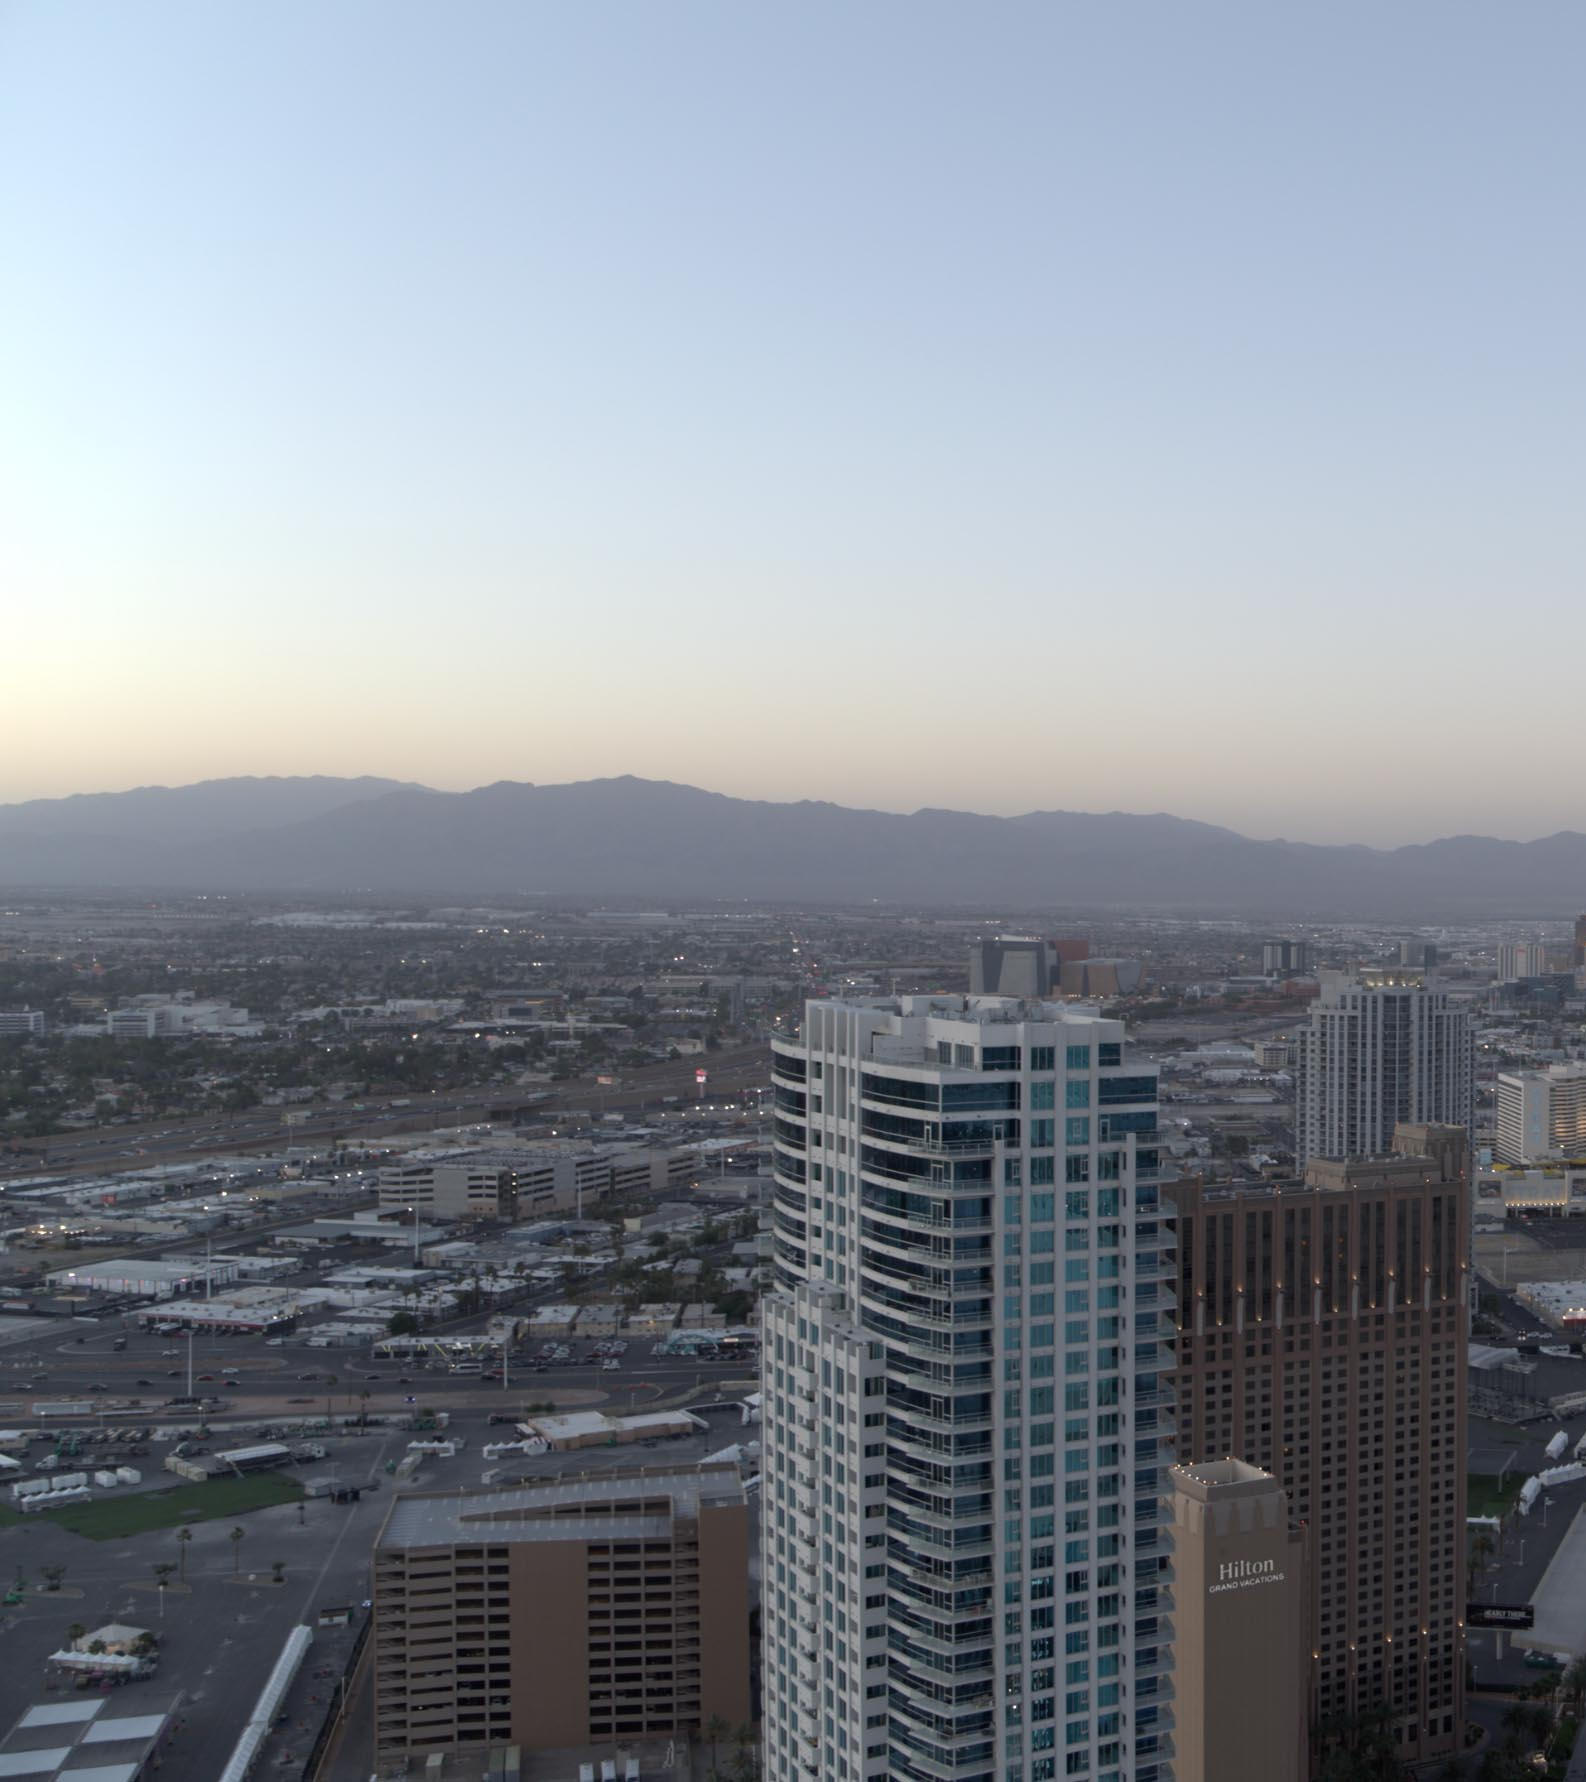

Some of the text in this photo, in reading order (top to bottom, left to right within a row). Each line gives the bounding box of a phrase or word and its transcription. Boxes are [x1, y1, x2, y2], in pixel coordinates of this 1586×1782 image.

[1220, 1560, 1274, 1580] Hilton
[1209, 1573, 1285, 1593] GRAND VACATIONS
